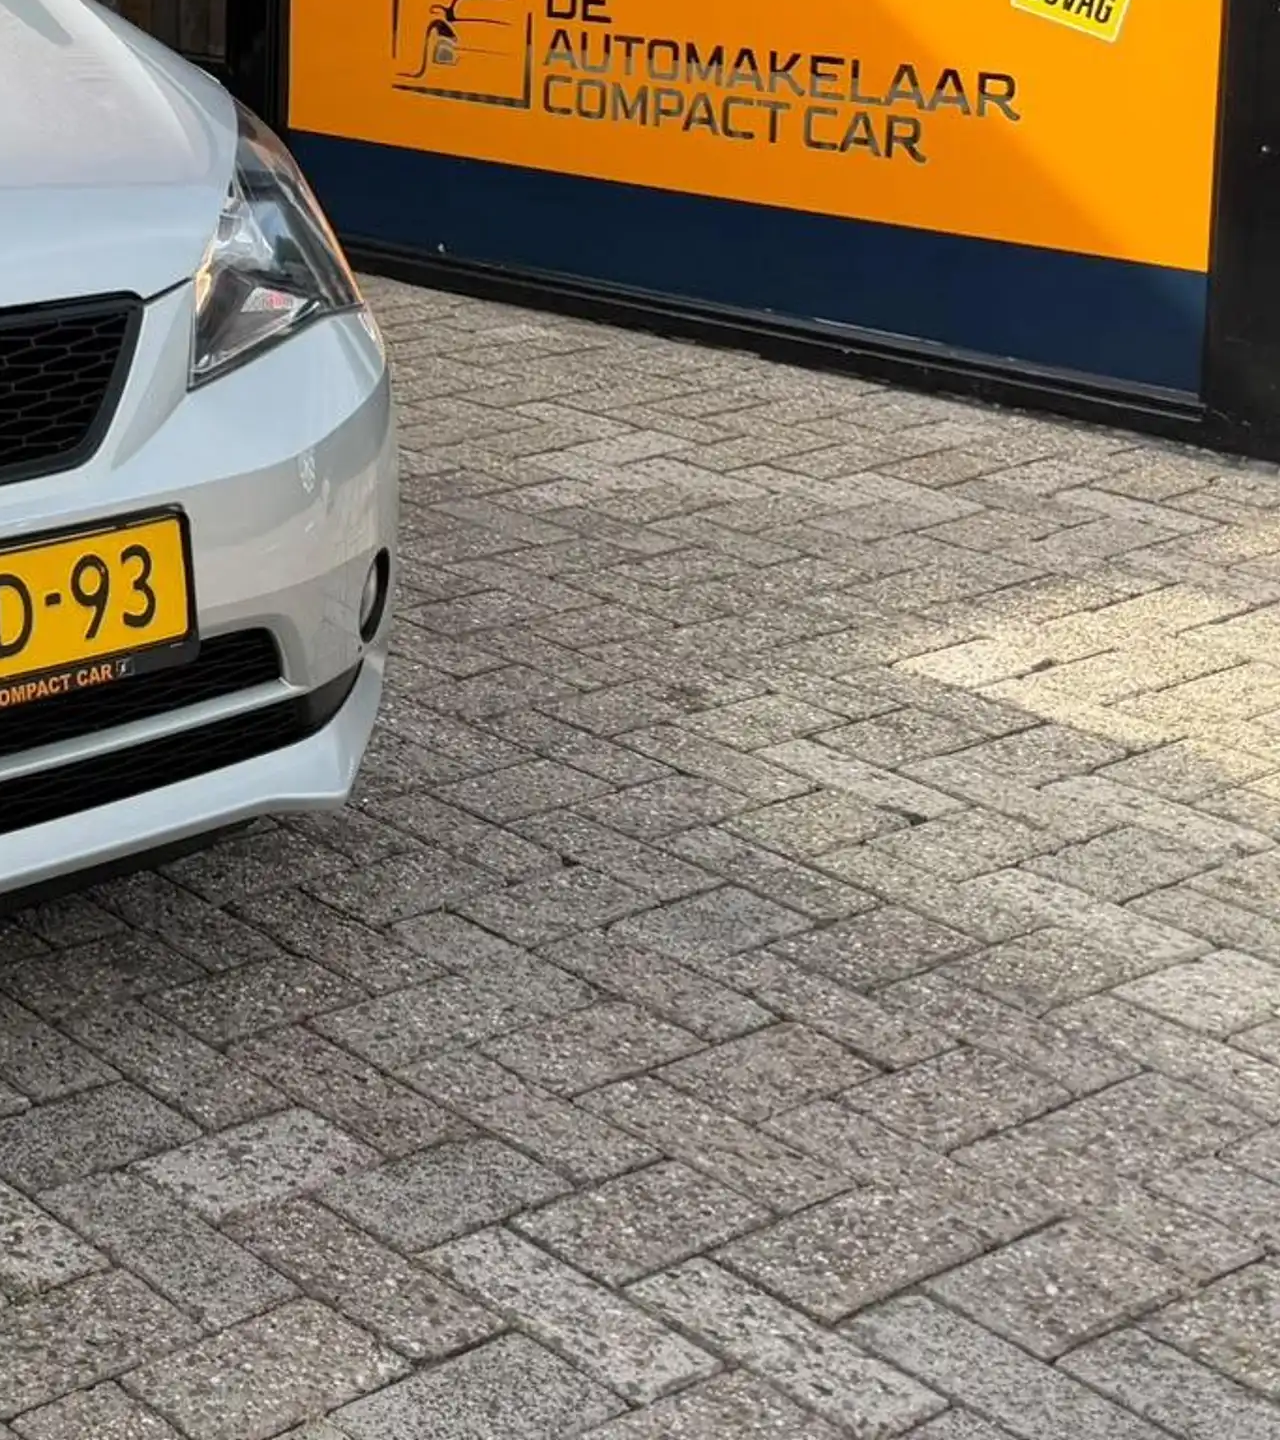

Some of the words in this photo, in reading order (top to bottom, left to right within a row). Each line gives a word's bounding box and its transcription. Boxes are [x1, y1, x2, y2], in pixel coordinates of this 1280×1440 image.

[543, 75, 789, 145] COMPACT
[802, 106, 928, 164] CAR
[544, 29, 1021, 121] AUTOMAKELAAR
[77, 664, 113, 688] CAR
